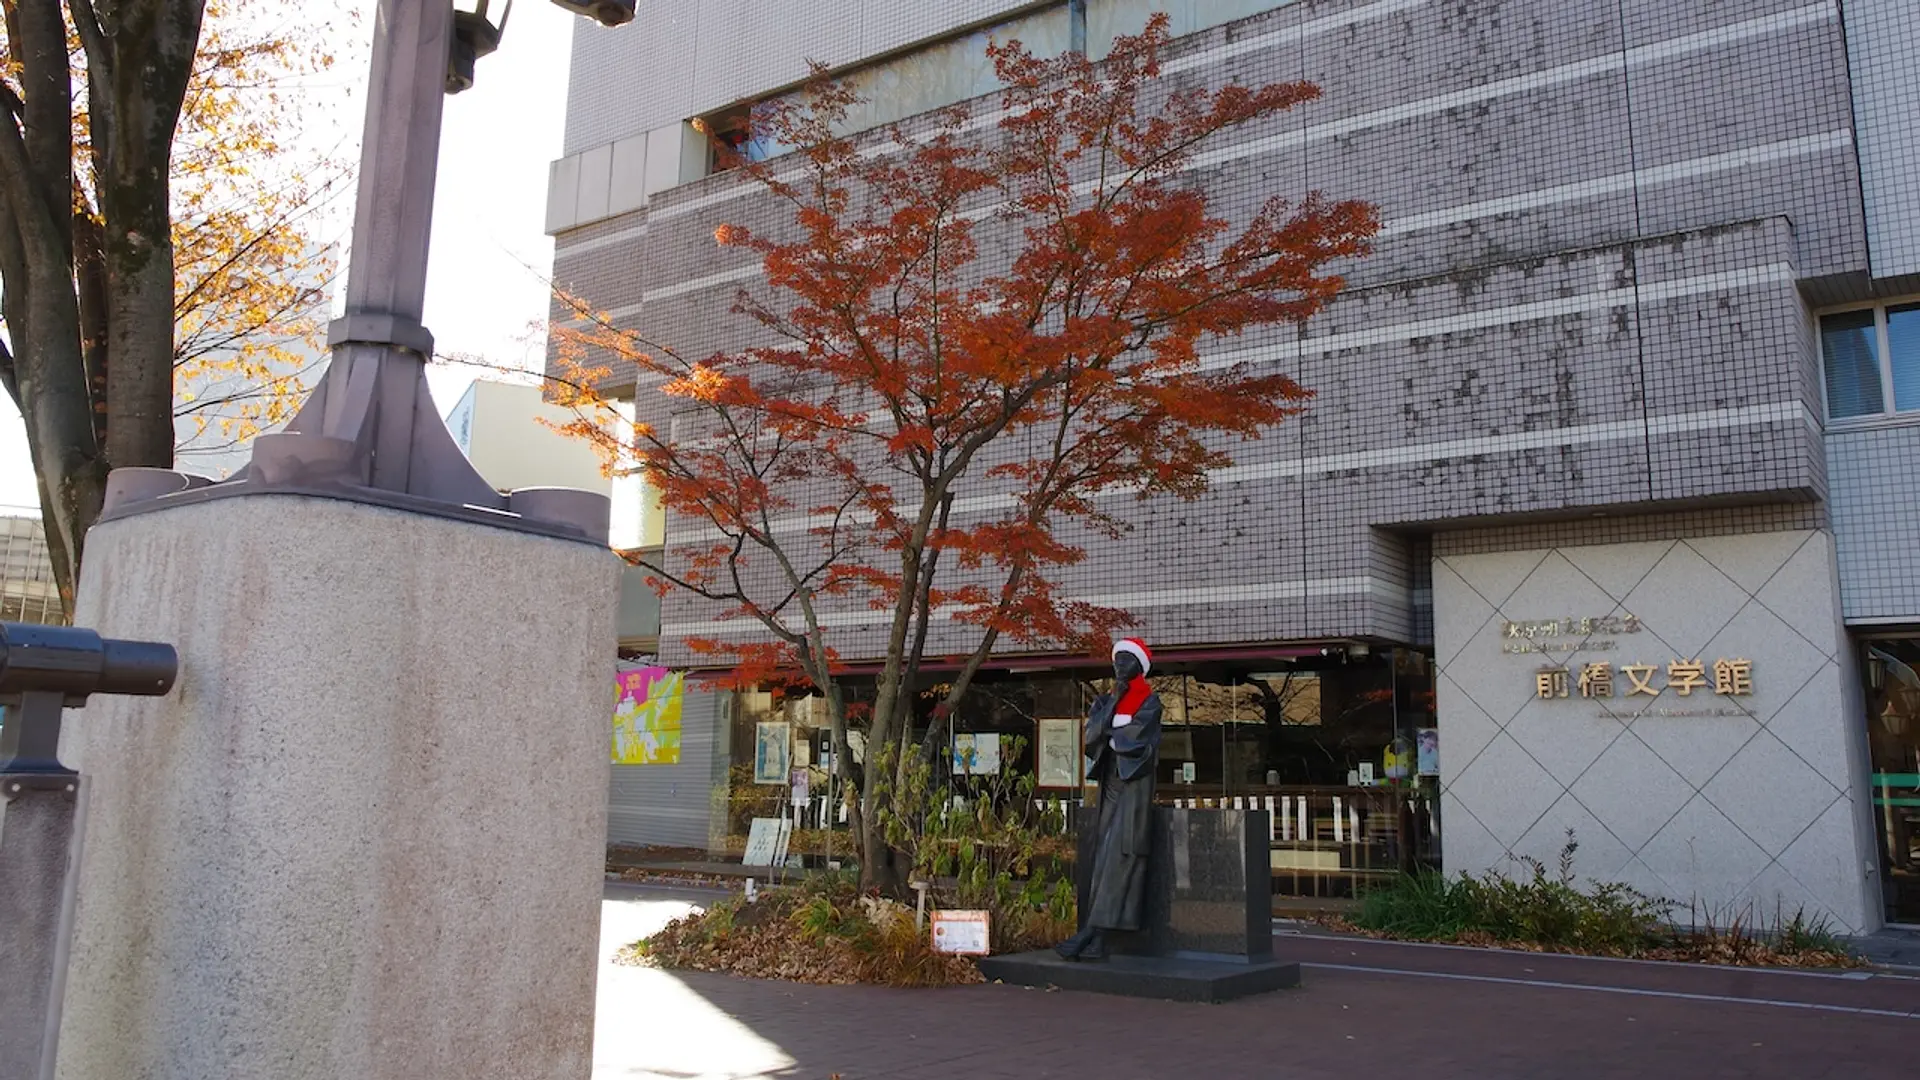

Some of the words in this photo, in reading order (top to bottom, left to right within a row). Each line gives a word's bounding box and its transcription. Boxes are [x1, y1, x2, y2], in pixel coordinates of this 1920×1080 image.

[1535, 657, 1755, 699] 前橋文学館
